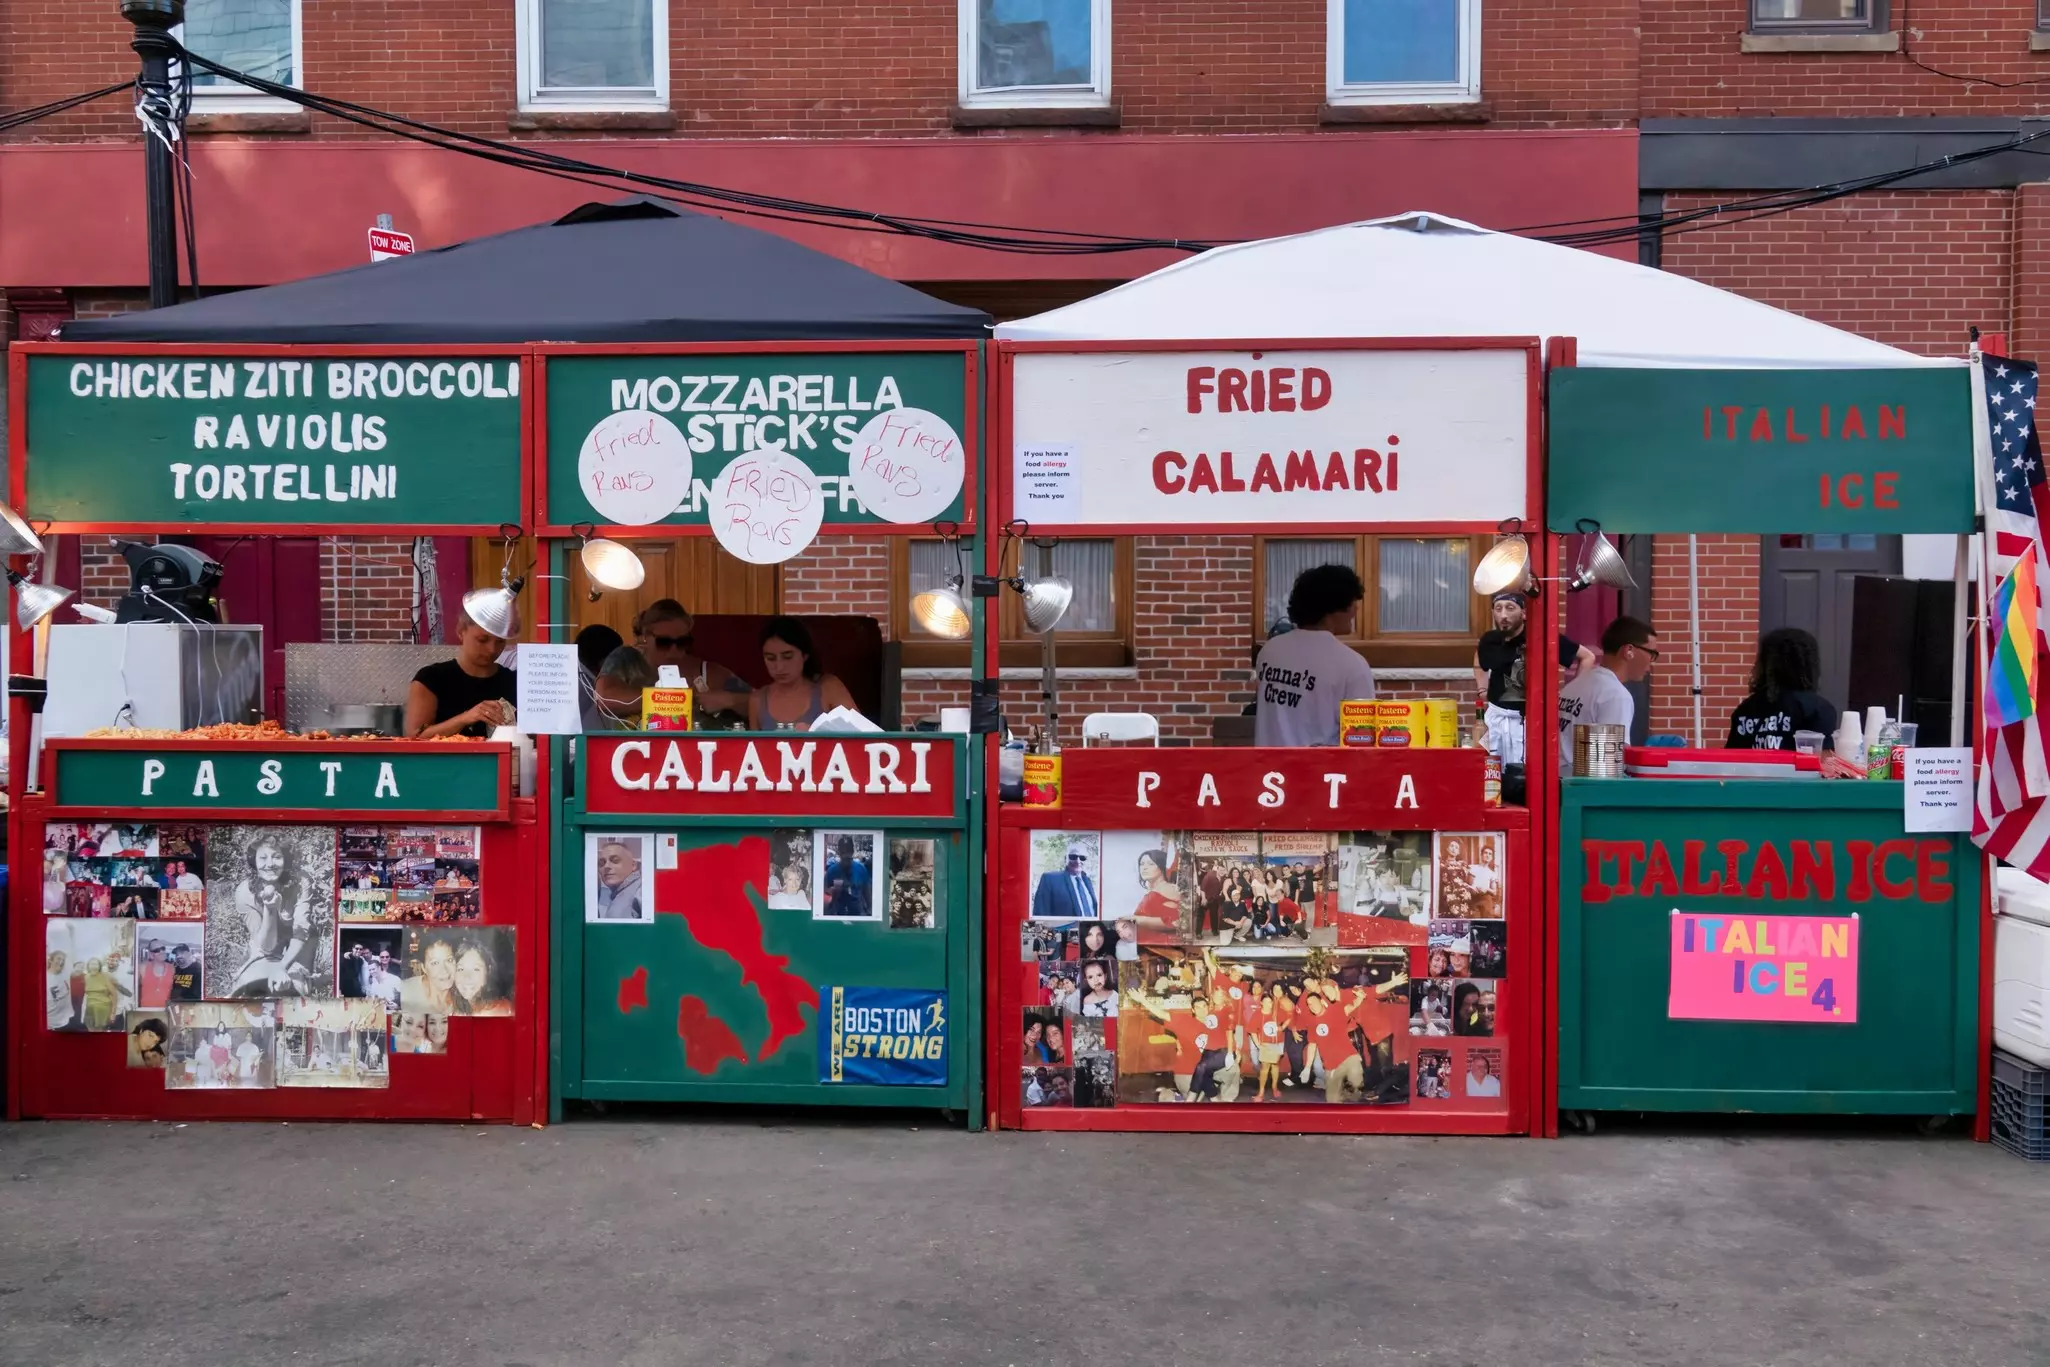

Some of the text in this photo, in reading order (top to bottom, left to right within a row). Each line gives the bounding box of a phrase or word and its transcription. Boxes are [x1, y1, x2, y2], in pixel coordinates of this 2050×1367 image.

[371, 235, 411, 252] TOW ZONE
[70, 361, 519, 399] CHICKEN ZITI BROCCOLI
[611, 375, 903, 412] MOZZARELLA
[194, 411, 387, 452] RAVIOLIS
[594, 418, 660, 461] Fried
[880, 414, 954, 463] Fried
[1703, 403, 1906, 442] ITALIAN
[170, 463, 396, 501] TORTELLINI
[1820, 471, 1899, 509] ICE
[1258, 662, 1316, 691] Jenna's
[1264, 683, 1302, 708] Crew
[654, 693, 684, 702] Pastene
[1345, 706, 1374, 714] Pastene
[1379, 706, 1407, 714] Pastene
[141, 759, 400, 798] PASTA
[611, 740, 932, 794] CALAMARI
[1136, 771, 1420, 808] PASTA
[1581, 838, 1955, 904] ITALIAN ICE
[1682, 918, 1849, 958] ITALIAN
[1733, 959, 1808, 996] ICE
[834, 991, 842, 1076] WE ARE
[844, 1007, 921, 1033] BOSTON
[843, 1034, 944, 1060] STRONG
